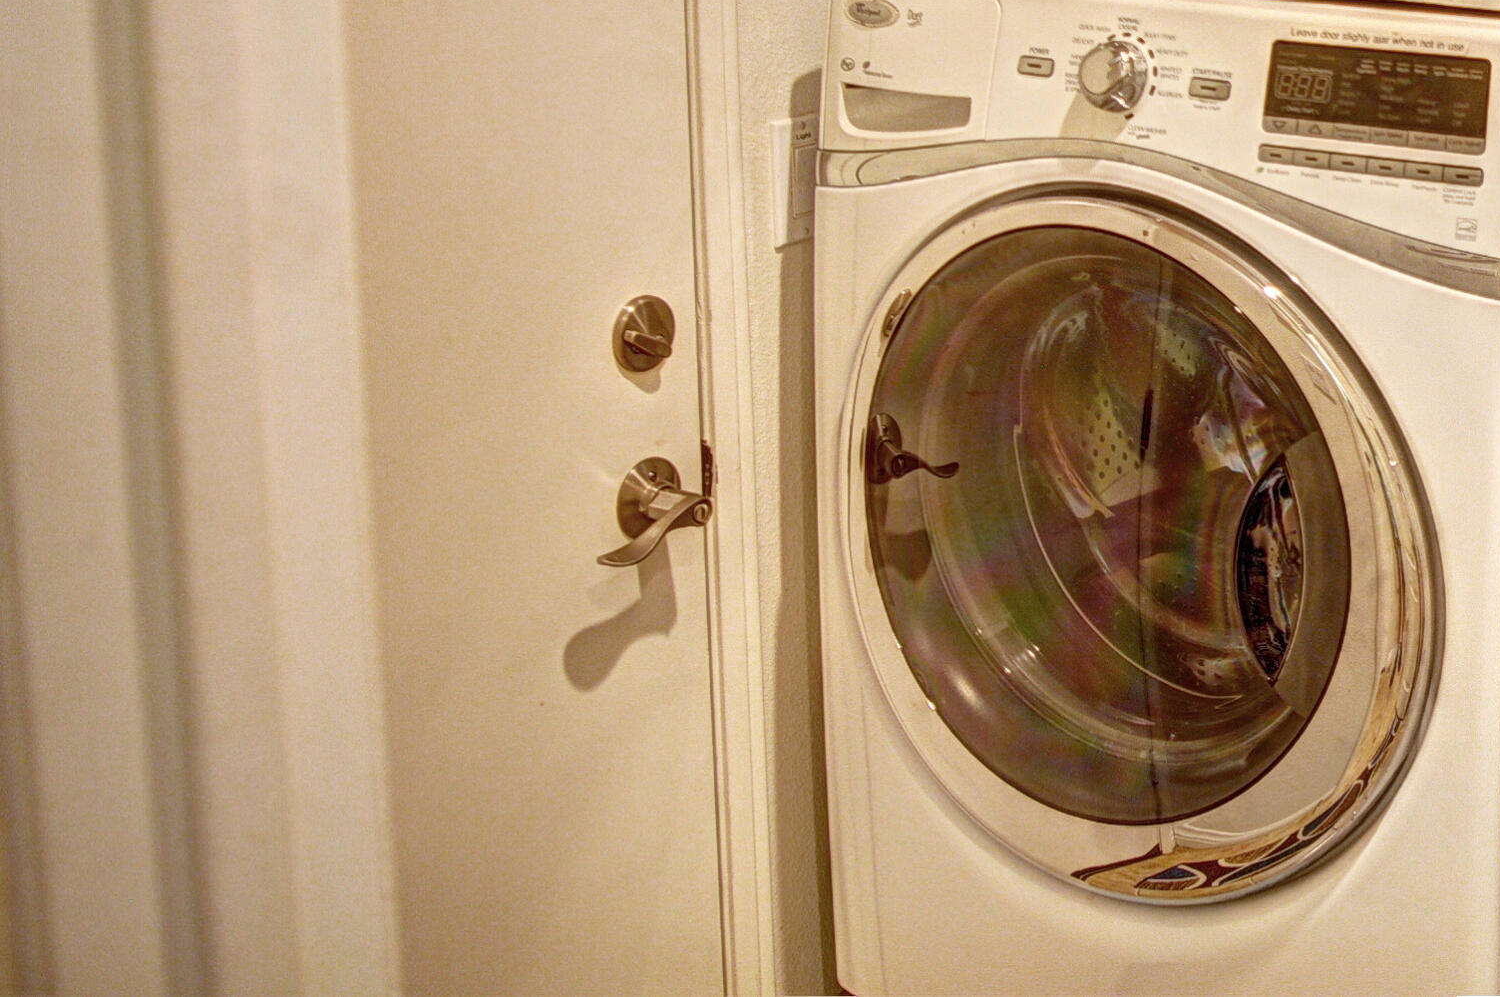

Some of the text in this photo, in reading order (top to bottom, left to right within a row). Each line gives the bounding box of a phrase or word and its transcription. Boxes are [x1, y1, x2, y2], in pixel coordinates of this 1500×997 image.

[1290, 27, 1318, 37] Leave
[1320, 30, 1340, 40] door
[1342, 31, 1370, 44] slightly
[1392, 35, 1417, 47] when
[1419, 39, 1434, 49] not
[1436, 41, 1445, 50] in
[1447, 43, 1464, 52] use
